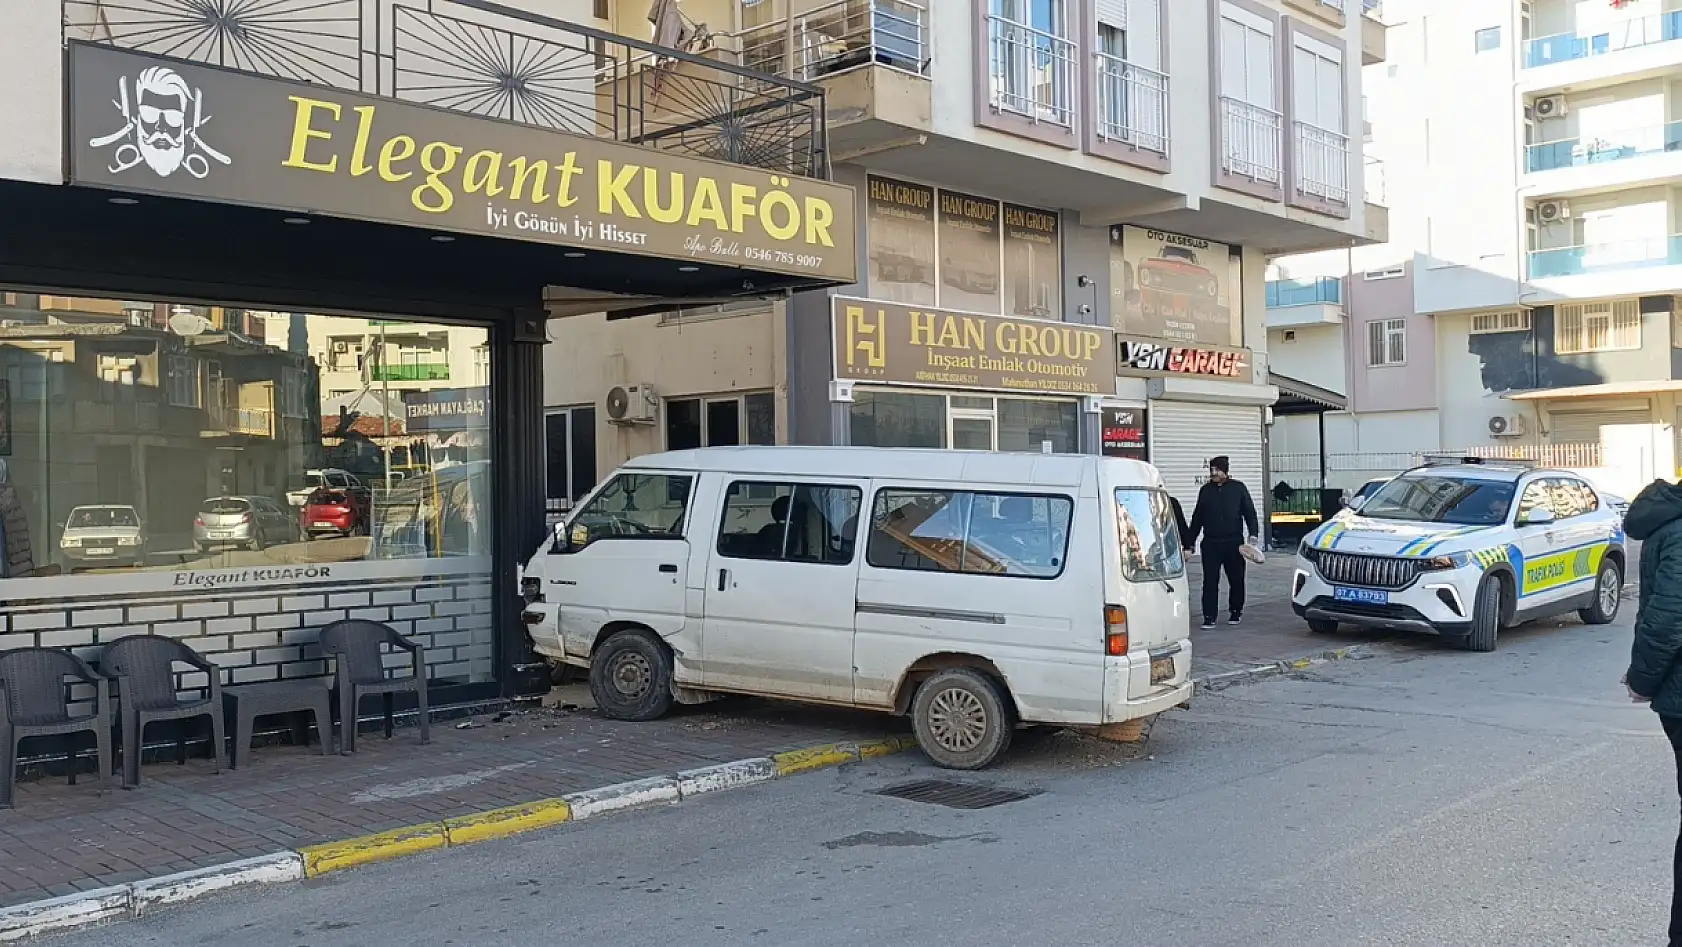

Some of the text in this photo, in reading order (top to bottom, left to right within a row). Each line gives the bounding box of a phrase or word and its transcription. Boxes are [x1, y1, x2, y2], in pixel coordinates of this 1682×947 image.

[281, 95, 836, 248] Elegant KUAFÖR
[870, 180, 931, 209] HAN GROUP
[941, 195, 962, 215] HAN
[964, 200, 996, 221] GROUP
[486, 202, 507, 230] İyi
[574, 215, 593, 241] İyi
[1005, 207, 1024, 226] HAN
[1025, 212, 1056, 232] GROUP
[1147, 230, 1209, 250] OTO AKSESUAR
[745, 247, 772, 261] 0546
[775, 251, 794, 265] 785
[796, 254, 823, 268] 9007
[909, 311, 1102, 361] HAN GROUP
[927, 347, 1089, 377] İnşaat Emlak Otomotiv
[1168, 347, 1244, 376] GARAGE
[1104, 427, 1143, 440] GARAGE
[173, 565, 330, 588] Elegant KUAFÖR
